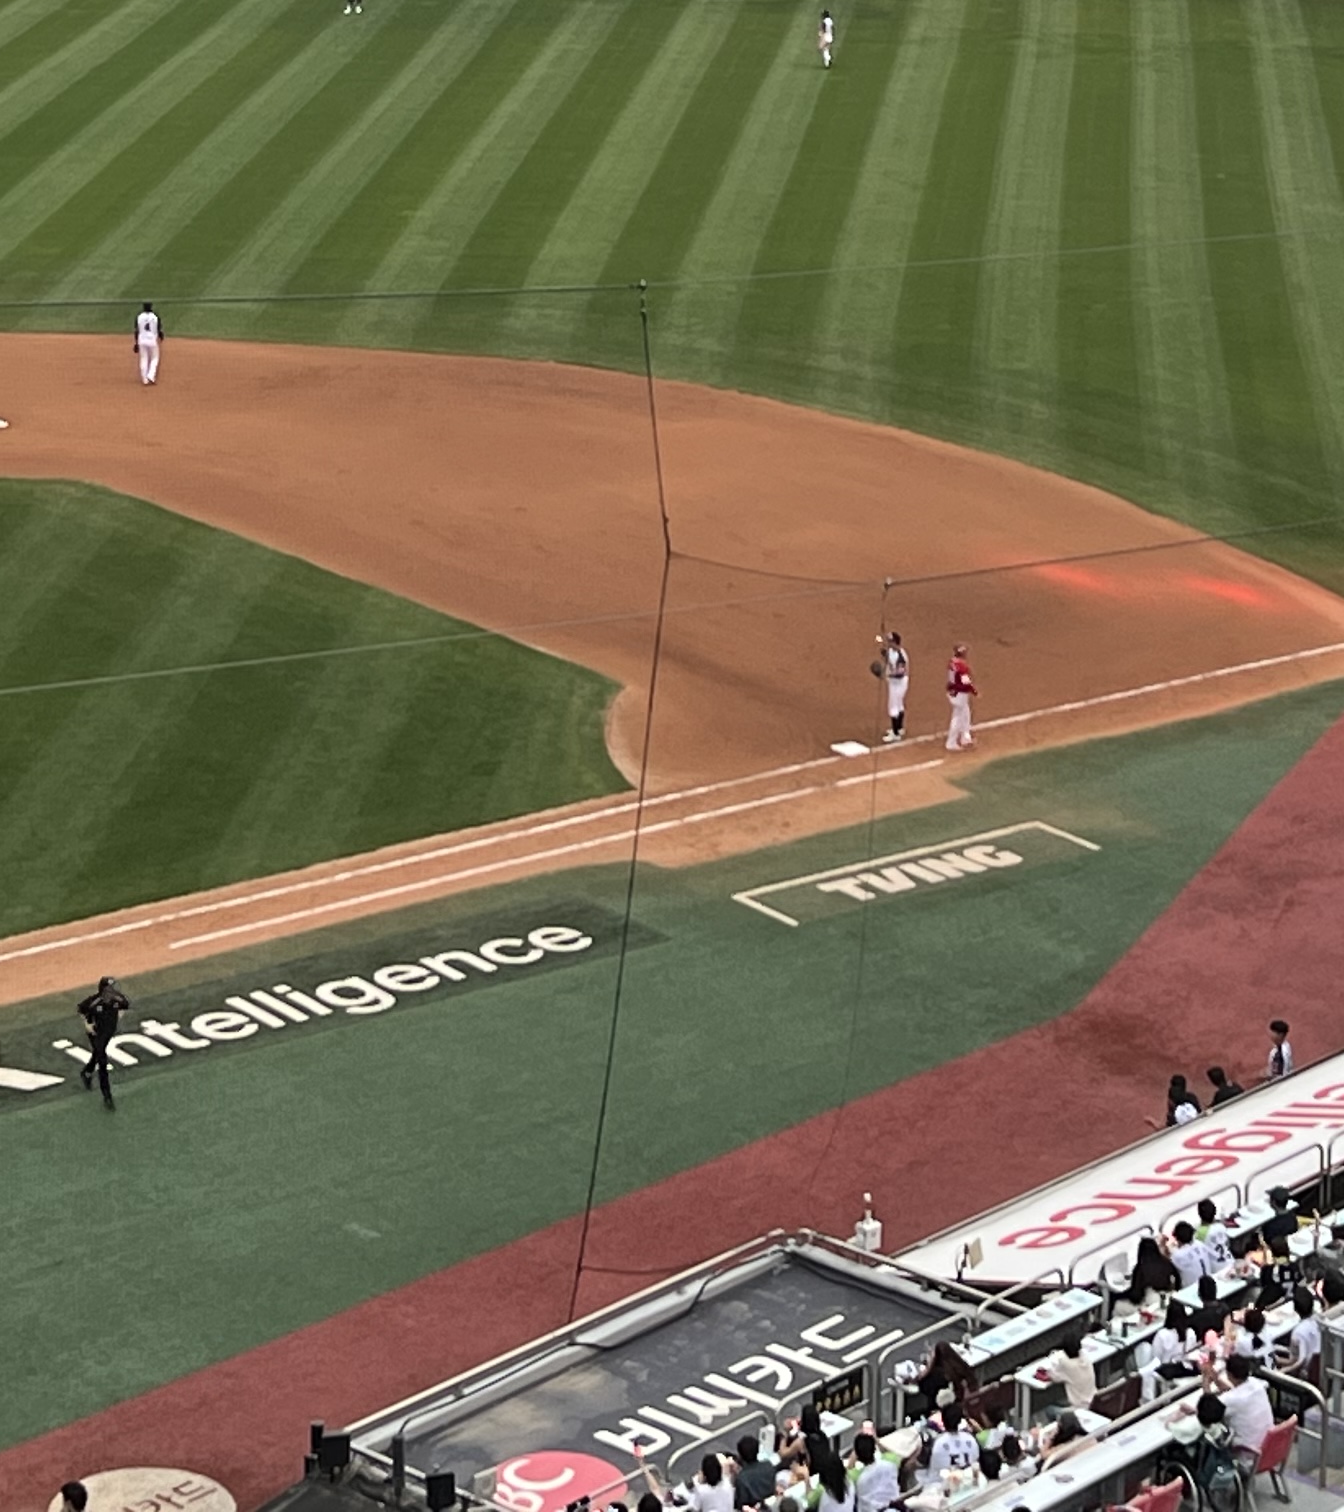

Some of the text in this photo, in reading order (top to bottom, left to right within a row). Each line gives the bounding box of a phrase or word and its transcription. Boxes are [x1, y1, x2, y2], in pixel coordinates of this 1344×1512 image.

[816, 840, 1024, 904] TVING
[51, 924, 595, 1078] intelligence
[591, 1312, 906, 1459] 비씨카드
[492, 1456, 577, 1512] BC
